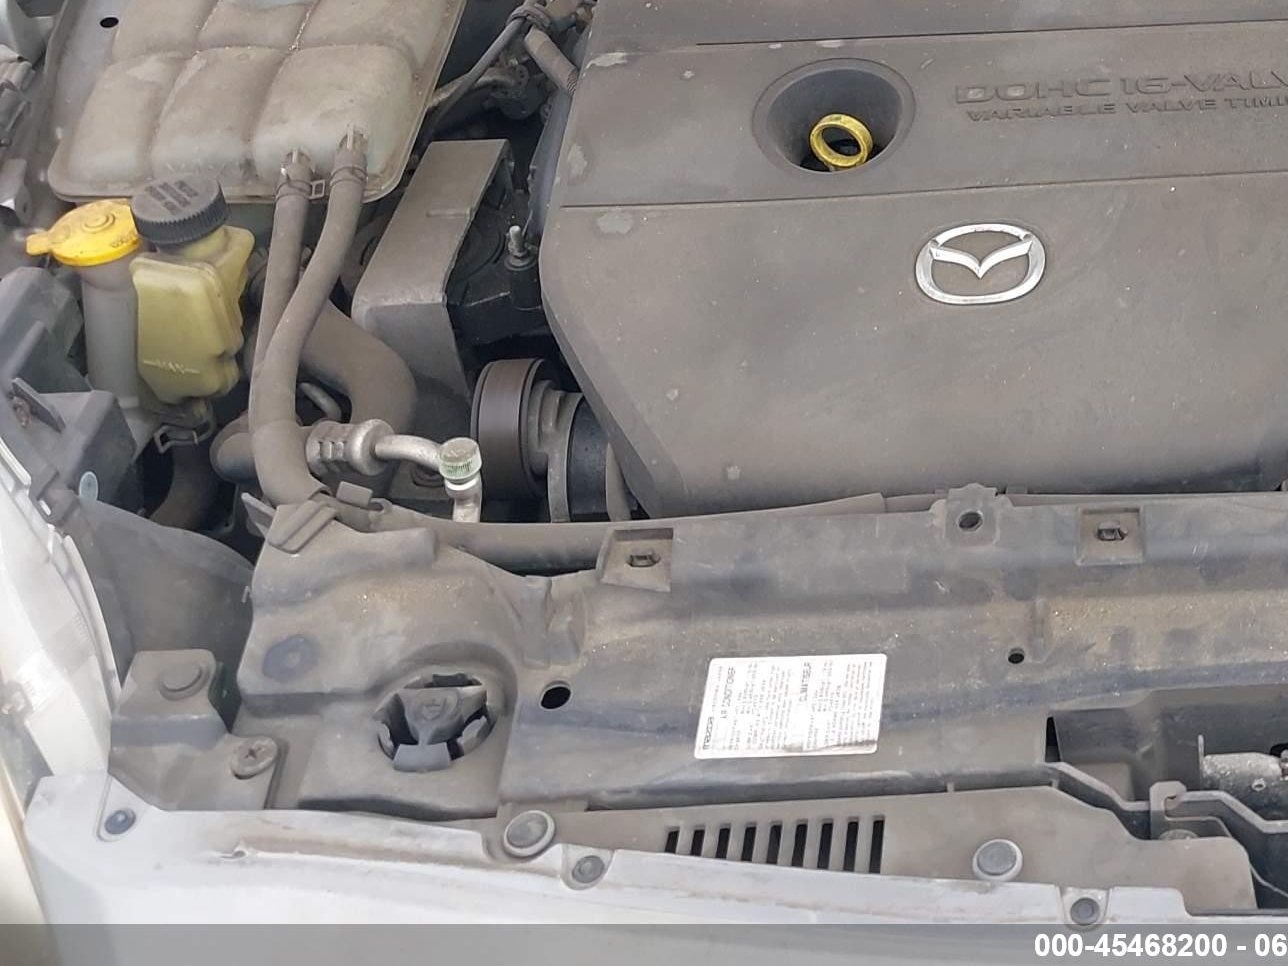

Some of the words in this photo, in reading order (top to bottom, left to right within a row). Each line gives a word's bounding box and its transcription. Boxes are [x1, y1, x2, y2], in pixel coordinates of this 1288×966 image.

[956, 78, 1111, 104] DOHC
[966, 103, 1116, 122] VARIABLE
[1126, 98, 1217, 113] VALVE
